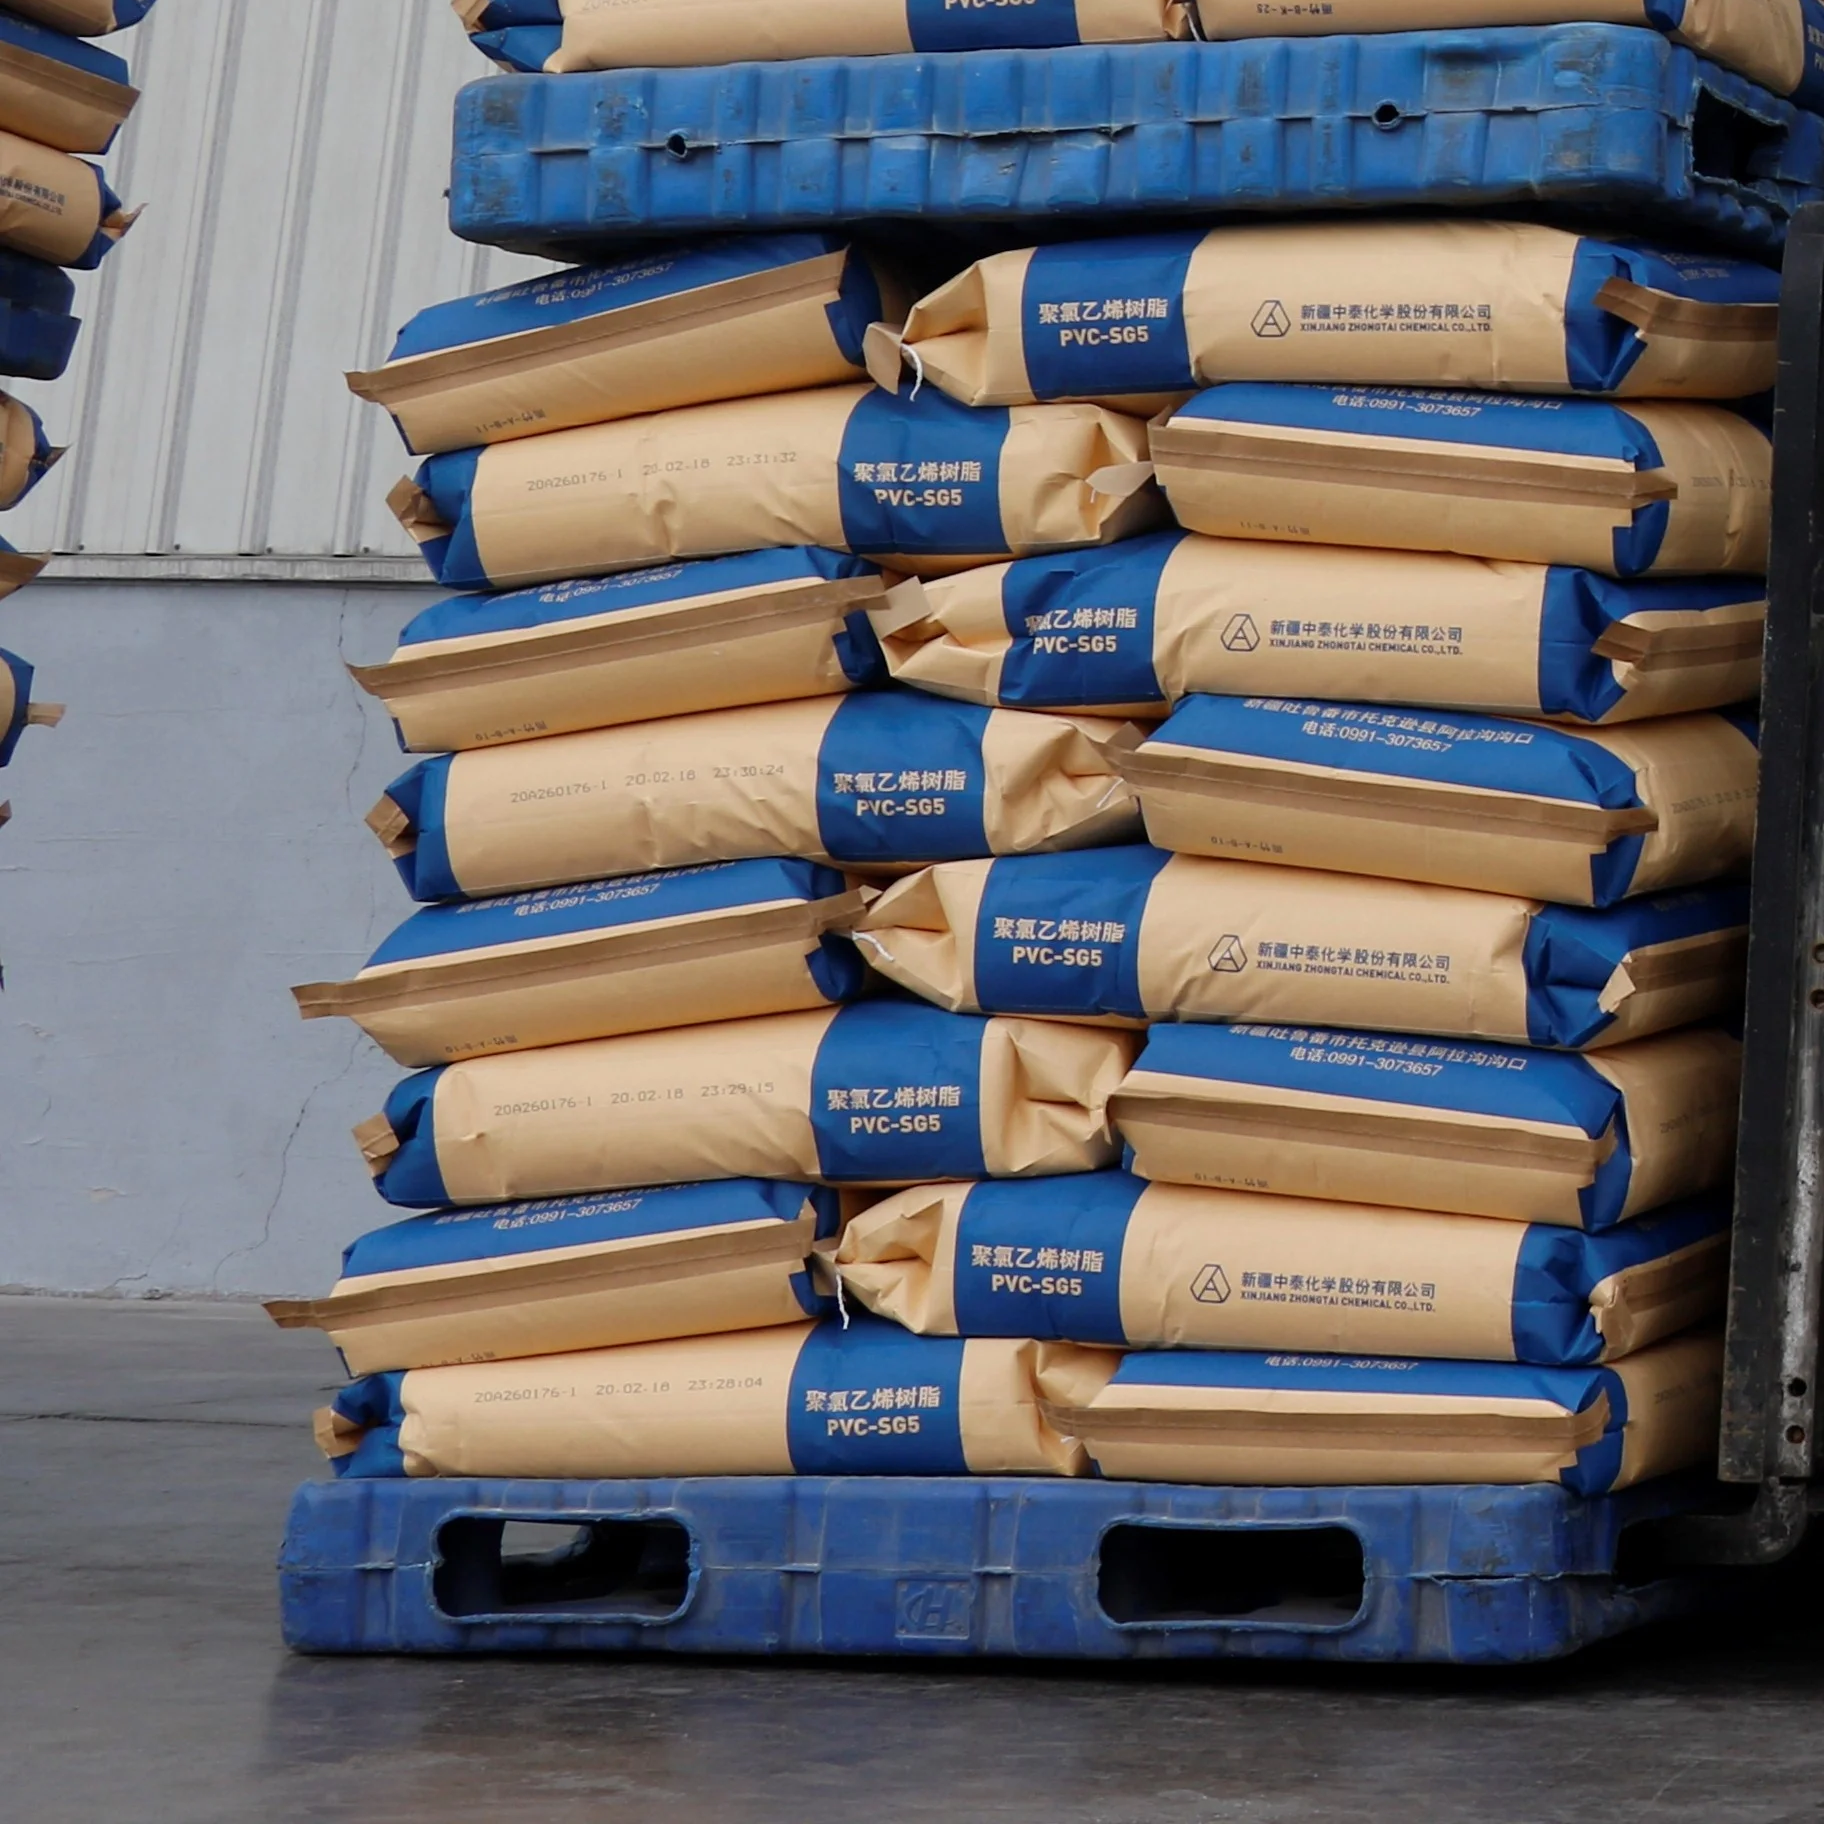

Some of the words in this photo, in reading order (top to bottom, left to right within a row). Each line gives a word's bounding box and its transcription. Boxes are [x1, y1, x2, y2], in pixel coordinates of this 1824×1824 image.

[1039, 297, 1168, 324] 聚氯乙烯树脂
[1301, 303, 1491, 320] 新疆中泰化学股份有限公司
[1059, 325, 1148, 346] PVC-SG5
[1300, 322, 1346, 331] XINJIANG
[1347, 322, 1397, 332] ZHONGTAI
[1399, 322, 1450, 332] CHEMICAL
[641, 458, 710, 477] 20.02.18
[726, 450, 797, 467] 23:31:32
[853, 460, 981, 482] 聚氯乙烯树脂
[874, 488, 962, 506] PVC-SG5
[1270, 619, 1462, 643] 新疆中泰化学股份有限公司
[1033, 635, 1116, 654] PVC-SG5
[1269, 638, 1315, 649] XINJIANG
[1316, 639, 1369, 651] ZHONGTAI
[1368, 642, 1422, 654] CHEMICAL
[1243, 699, 1533, 744] 新疆吐鲁番市托克逊县阿拉沟沟口
[624, 769, 696, 787] 20.02.18
[712, 764, 784, 784] 23:30:24
[834, 769, 966, 793] 聚氯乙烯树脂
[856, 797, 945, 816] PVC-SG5
[993, 917, 1125, 942] 聚氯乙烯树脂
[1013, 945, 1102, 966] PVC-SG5
[1256, 941, 1450, 972] 新疆中泰化学股份有限公司
[1256, 960, 1305, 973] XINJIANG
[1304, 963, 1357, 976] ZHONGTAI
[1355, 967, 1409, 981] CHEMICAL
[1229, 1025, 1527, 1071] 新疆吐鲁番市托克逊县阿拉沟沟口
[610, 1087, 684, 1105] 20.02.18
[700, 1081, 774, 1100] 23:29:15
[827, 1085, 961, 1110] 聚氯乙烯树脂
[850, 1114, 940, 1134] PVC-SG5
[971, 1244, 1104, 1272] 聚氯乙烯树脂
[992, 1274, 1082, 1296] PVC-SG5
[1240, 1271, 1435, 1300] 新疆中泰化学股份有限公司
[1240, 1290, 1286, 1302] XINJIANG
[1289, 1293, 1338, 1306] ZHONGTAI
[1340, 1296, 1392, 1309] CHEMICAL
[595, 1381, 670, 1396] 20.02.18
[687, 1376, 762, 1391] 23:28:04
[805, 1385, 940, 1412] 聚氯乙烯树脂
[827, 1415, 919, 1436] PVC-SG5
